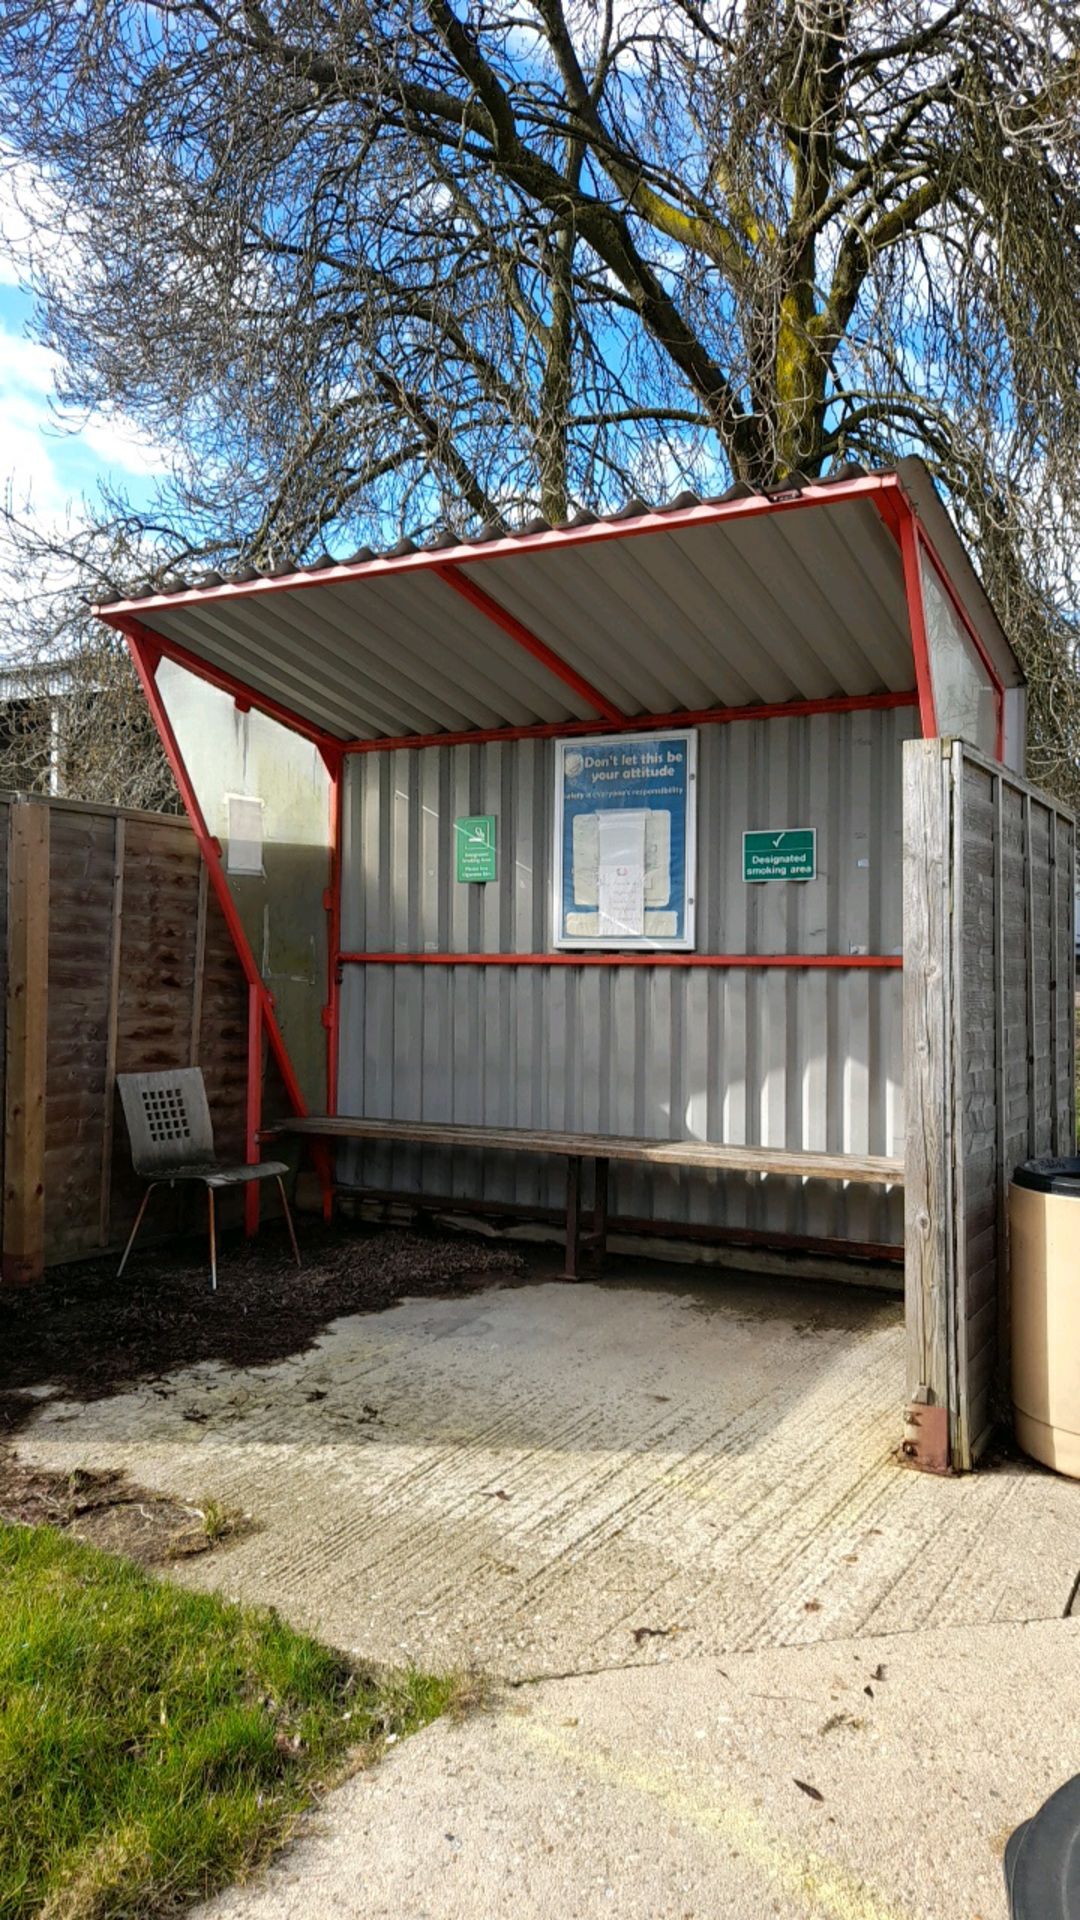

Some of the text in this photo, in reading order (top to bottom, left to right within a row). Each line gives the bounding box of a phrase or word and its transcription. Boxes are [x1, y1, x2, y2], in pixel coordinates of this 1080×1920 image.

[584, 751, 683, 768] Don't let this be
[592, 765, 675, 783] your attitude
[631, 787, 684, 796] responsibility
[752, 854, 806, 865] Designated
[747, 865, 812, 876] smoking area
